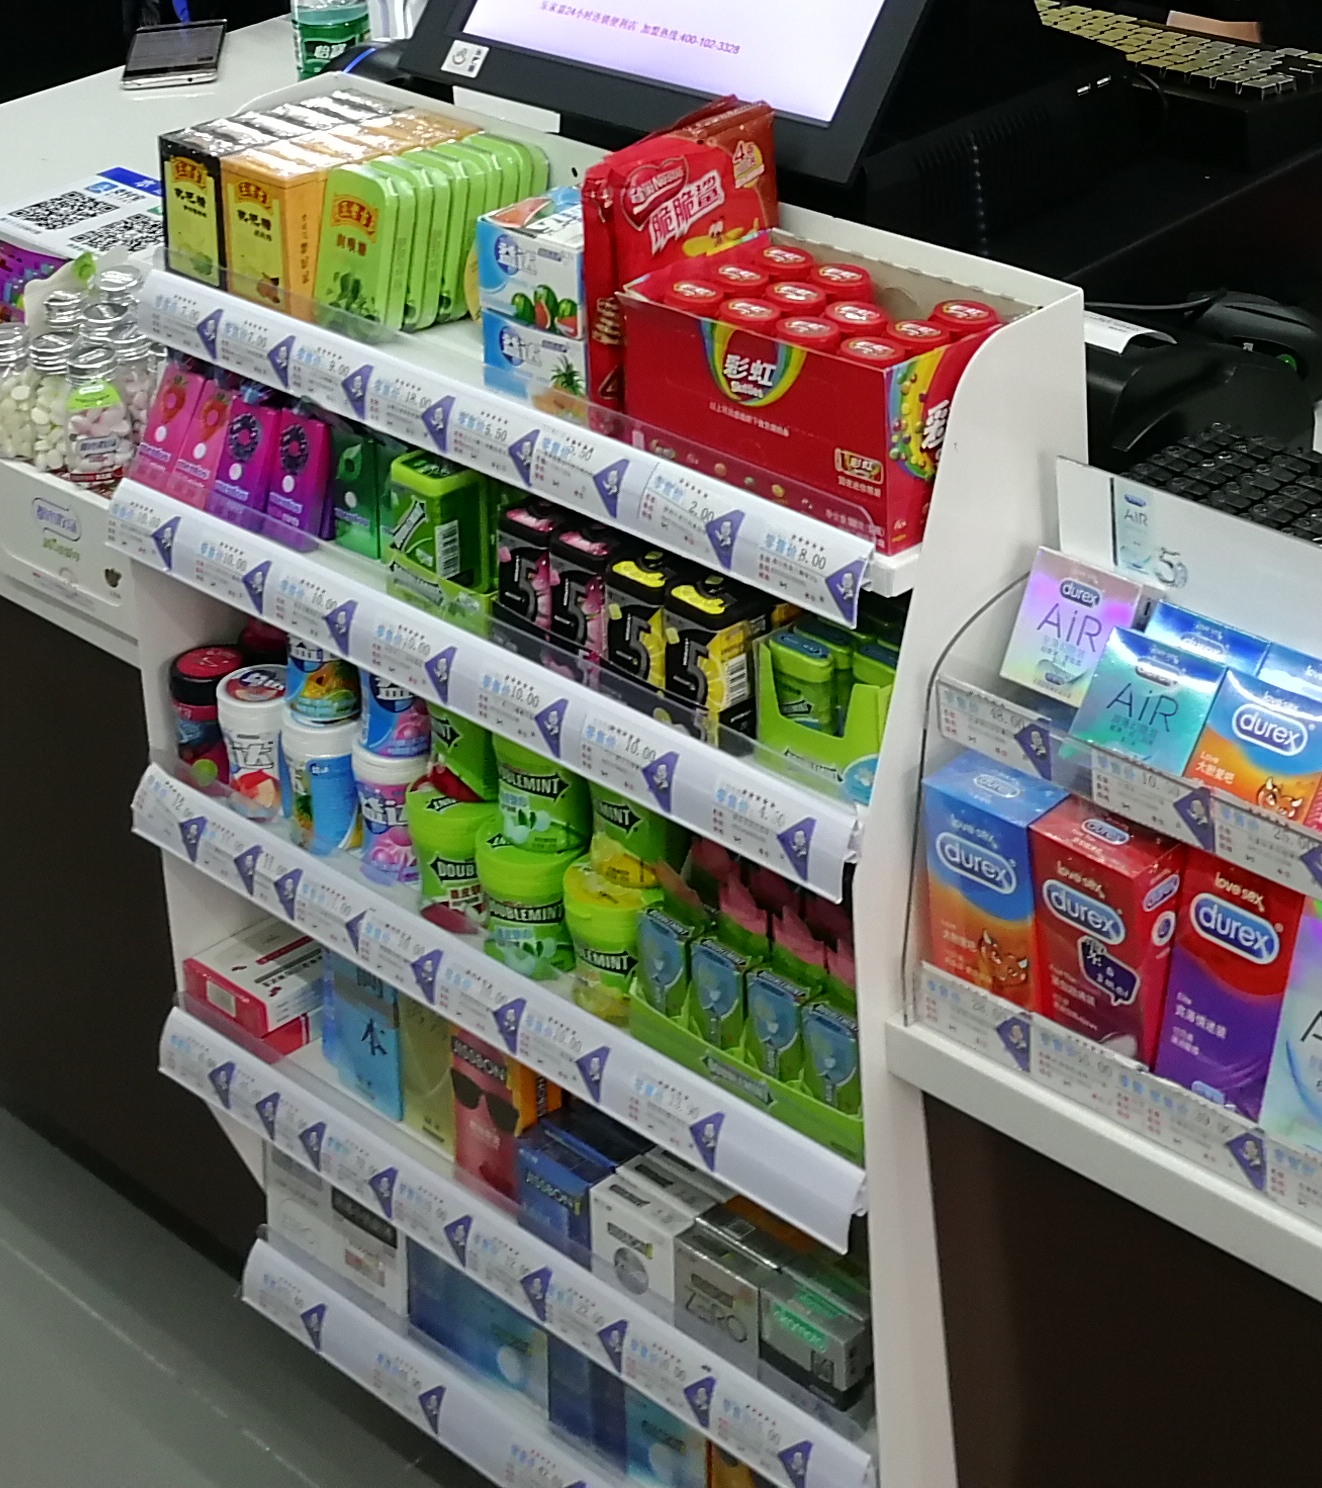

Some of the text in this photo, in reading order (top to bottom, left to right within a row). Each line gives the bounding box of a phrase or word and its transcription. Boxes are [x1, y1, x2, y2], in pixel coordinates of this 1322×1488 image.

[723, 354, 778, 387] 彩虹
[687, 500, 715, 521] 2.00
[798, 548, 827, 570] 8.00
[509, 686, 540, 709] 10.00
[942, 839, 1011, 889] durex
[1049, 888, 1123, 941] durex
[1197, 900, 1273, 957] durex
